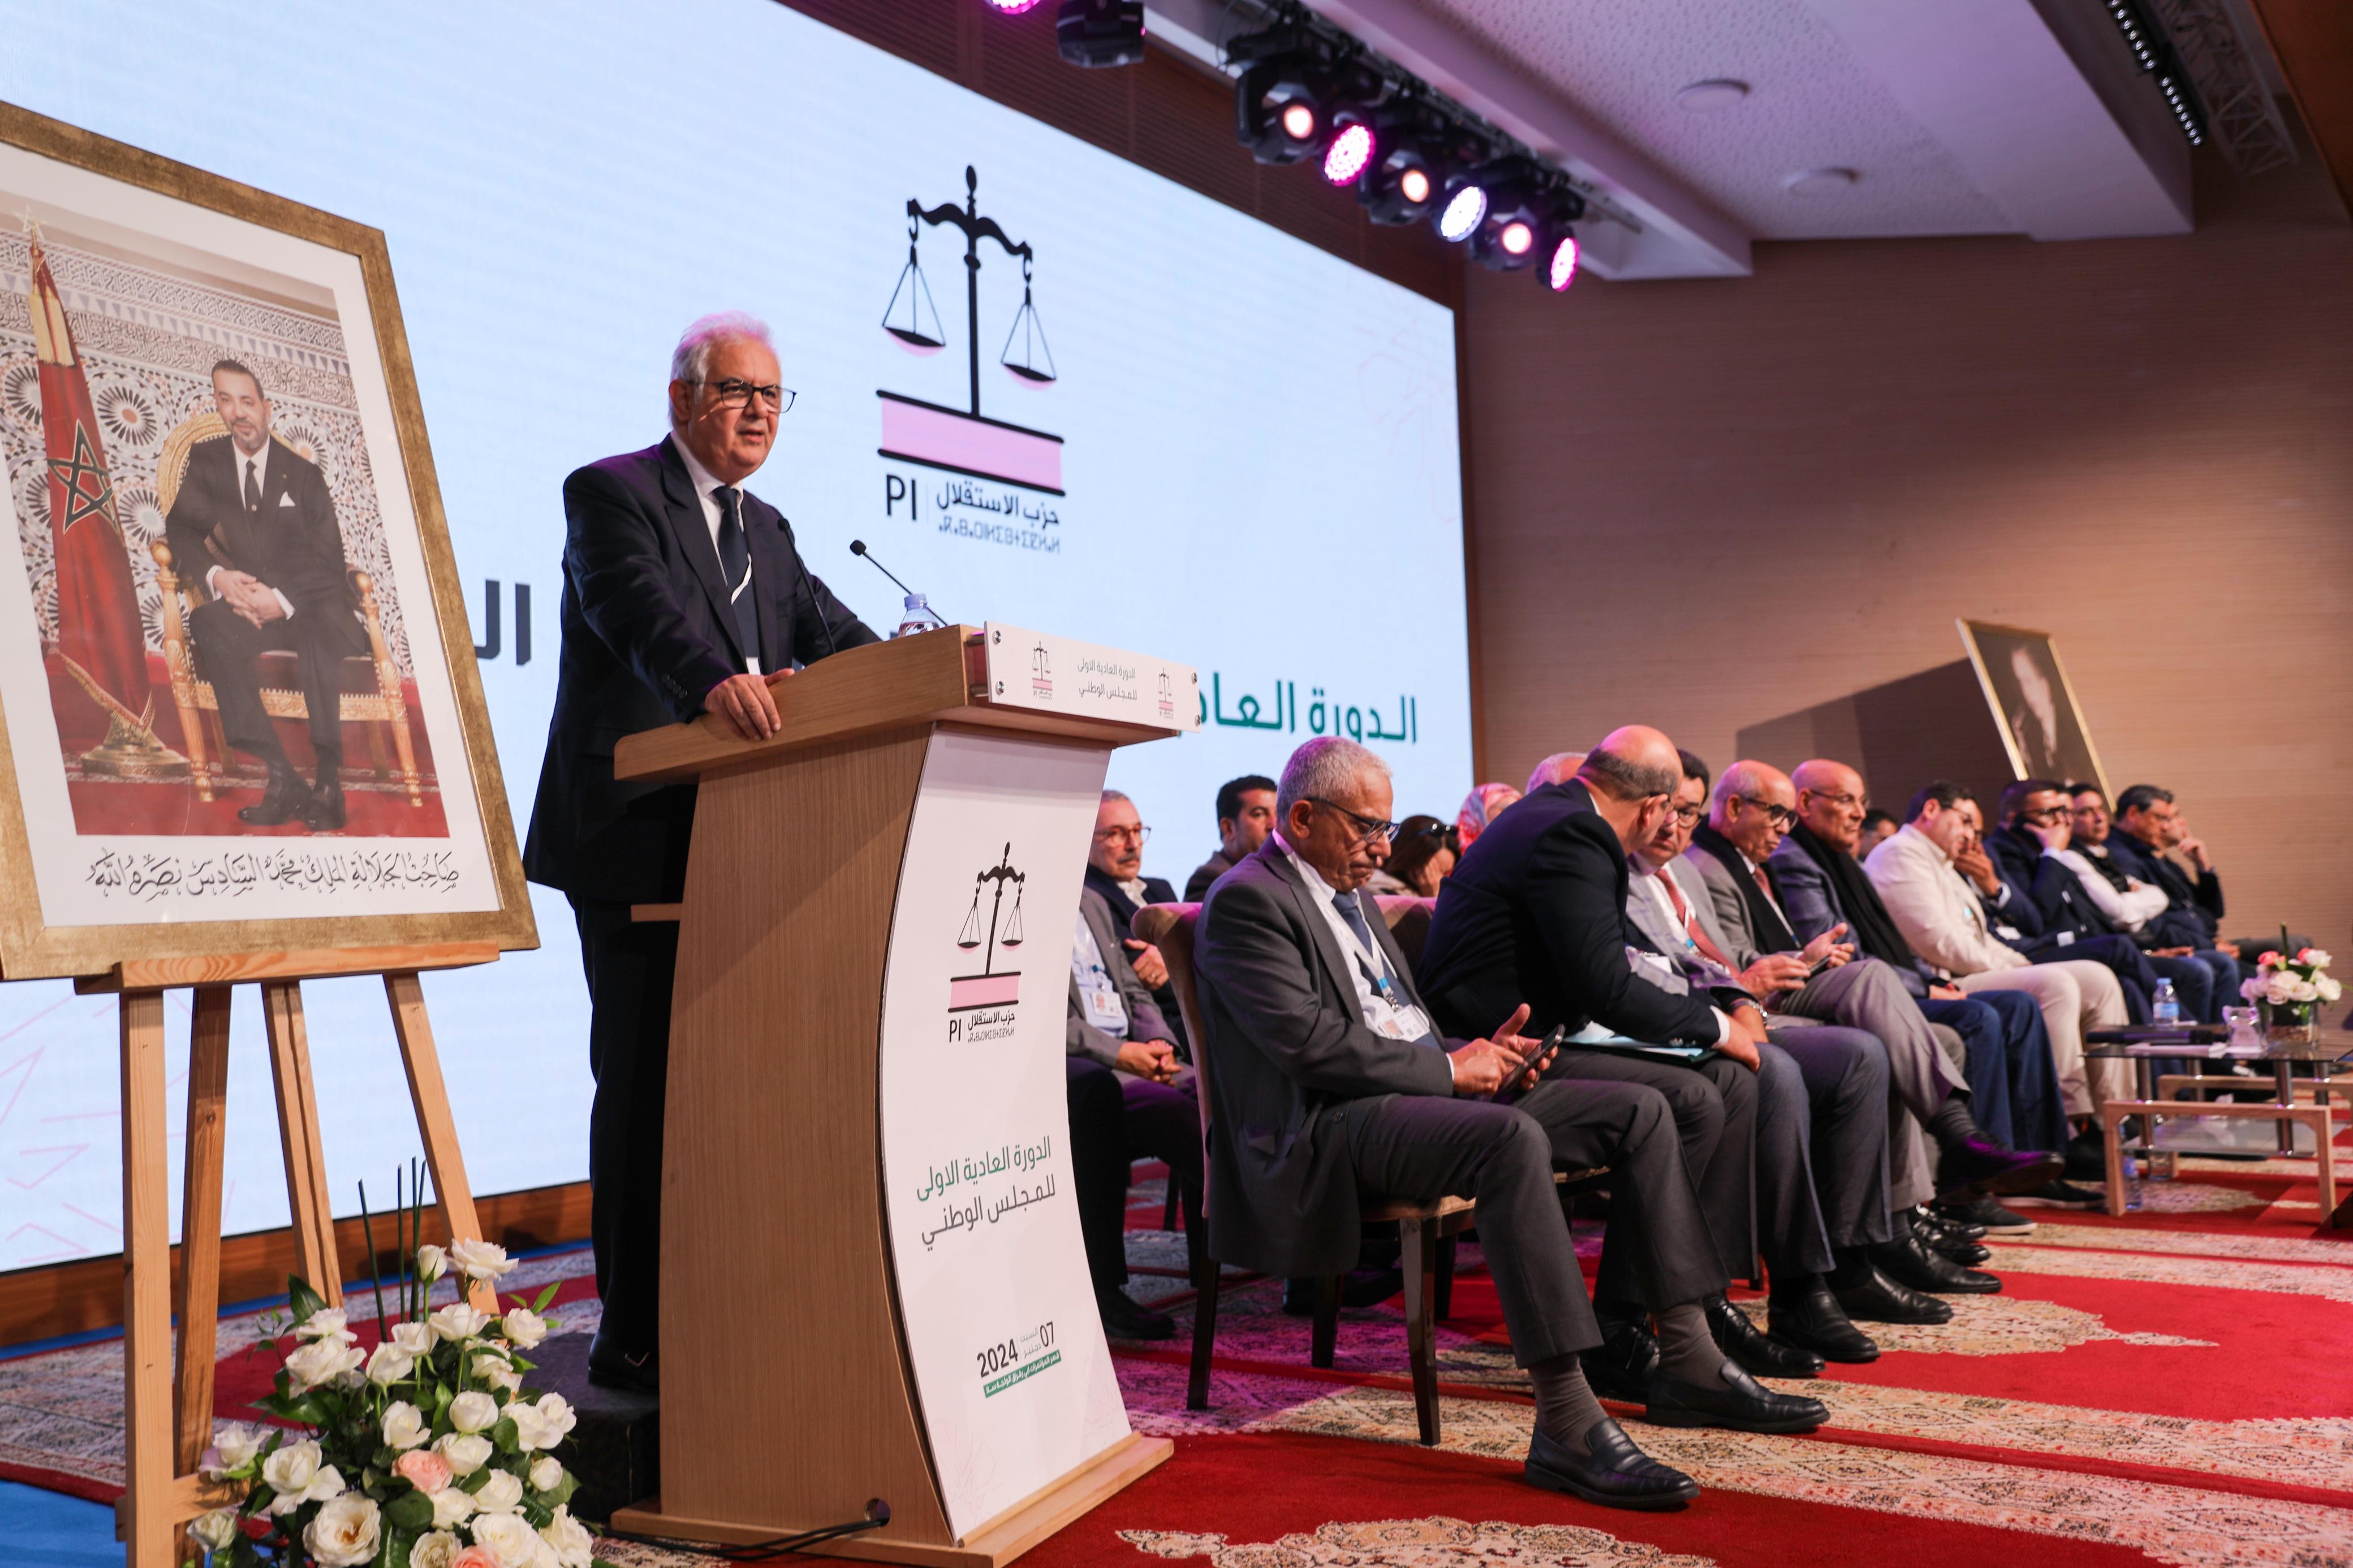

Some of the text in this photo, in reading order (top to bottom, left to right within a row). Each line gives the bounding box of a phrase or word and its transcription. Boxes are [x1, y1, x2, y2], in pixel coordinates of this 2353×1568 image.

[886, 474, 917, 521] PI
[936, 480, 1059, 530] حزب الاستقلال
[1097, 660, 1117, 676] العادية
[1119, 666, 1136, 681] الدورة
[1079, 681, 1137, 701] للمجلس الوطني
[1309, 688, 1416, 744] الدورة
[949, 1018, 962, 1043] PI
[968, 1010, 1015, 1030] حزب الاستقلال
[917, 1135, 1051, 1202] الدورة العادية الاولى
[921, 1173, 1055, 1251] للمجلس الوطني
[1040, 1321, 1054, 1347] 07
[977, 1338, 1018, 1378] 2024
